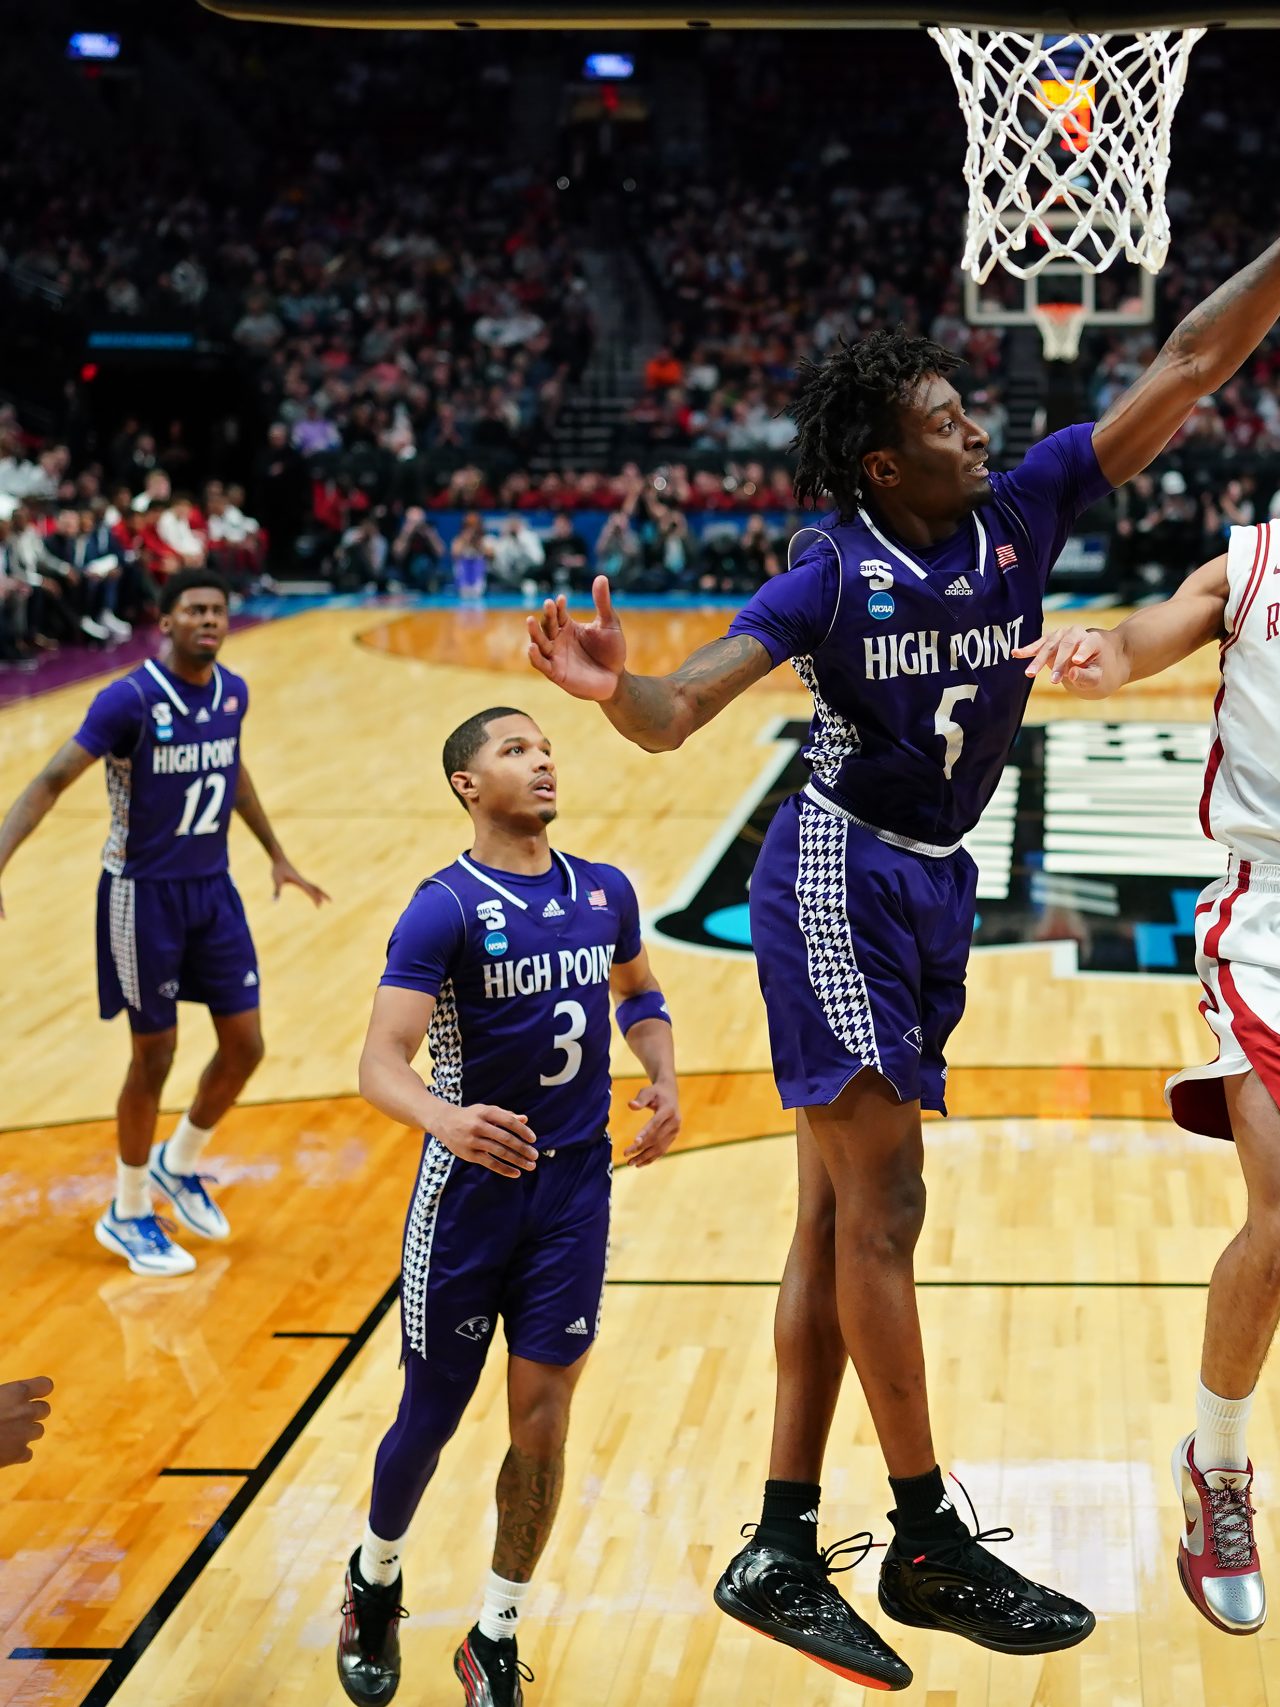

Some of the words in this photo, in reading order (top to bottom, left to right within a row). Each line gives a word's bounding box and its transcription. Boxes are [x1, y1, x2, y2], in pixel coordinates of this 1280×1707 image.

[860, 564, 878, 572] BIG
[944, 587, 974, 596] adidas
[871, 604, 893, 613] NCAA
[863, 630, 940, 680] HIGH
[950, 615, 1024, 671] POINT
[934, 684, 979, 780] 5
[153, 743, 200, 774] HIGH
[174, 772, 227, 837] 12
[542, 909, 565, 918] adidas
[488, 942, 507, 951] NCAA
[483, 953, 552, 999] HIGH
[539, 1000, 587, 1087] 3
